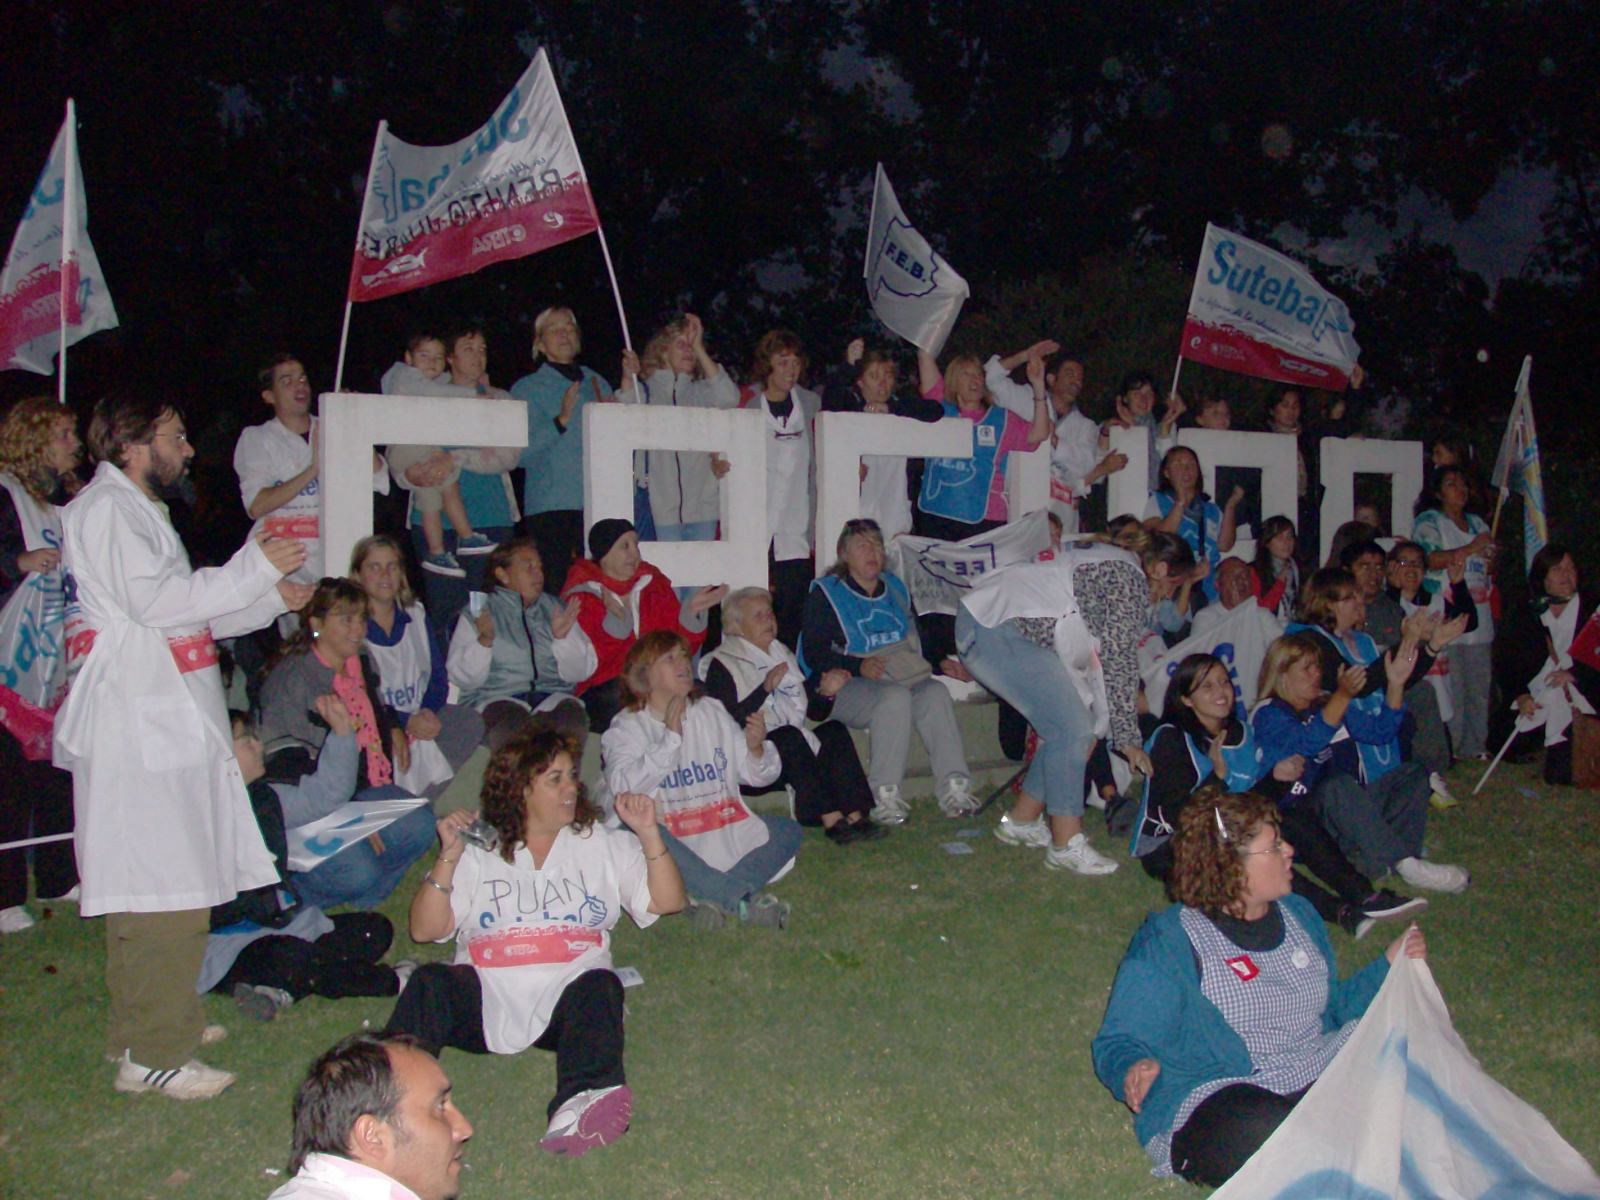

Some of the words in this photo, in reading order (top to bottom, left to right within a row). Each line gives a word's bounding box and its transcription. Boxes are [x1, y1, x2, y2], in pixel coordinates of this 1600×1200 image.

[884, 242, 927, 284] F.E.B.
[1207, 240, 1322, 325] Suteba
[483, 869, 588, 918] PUAN
